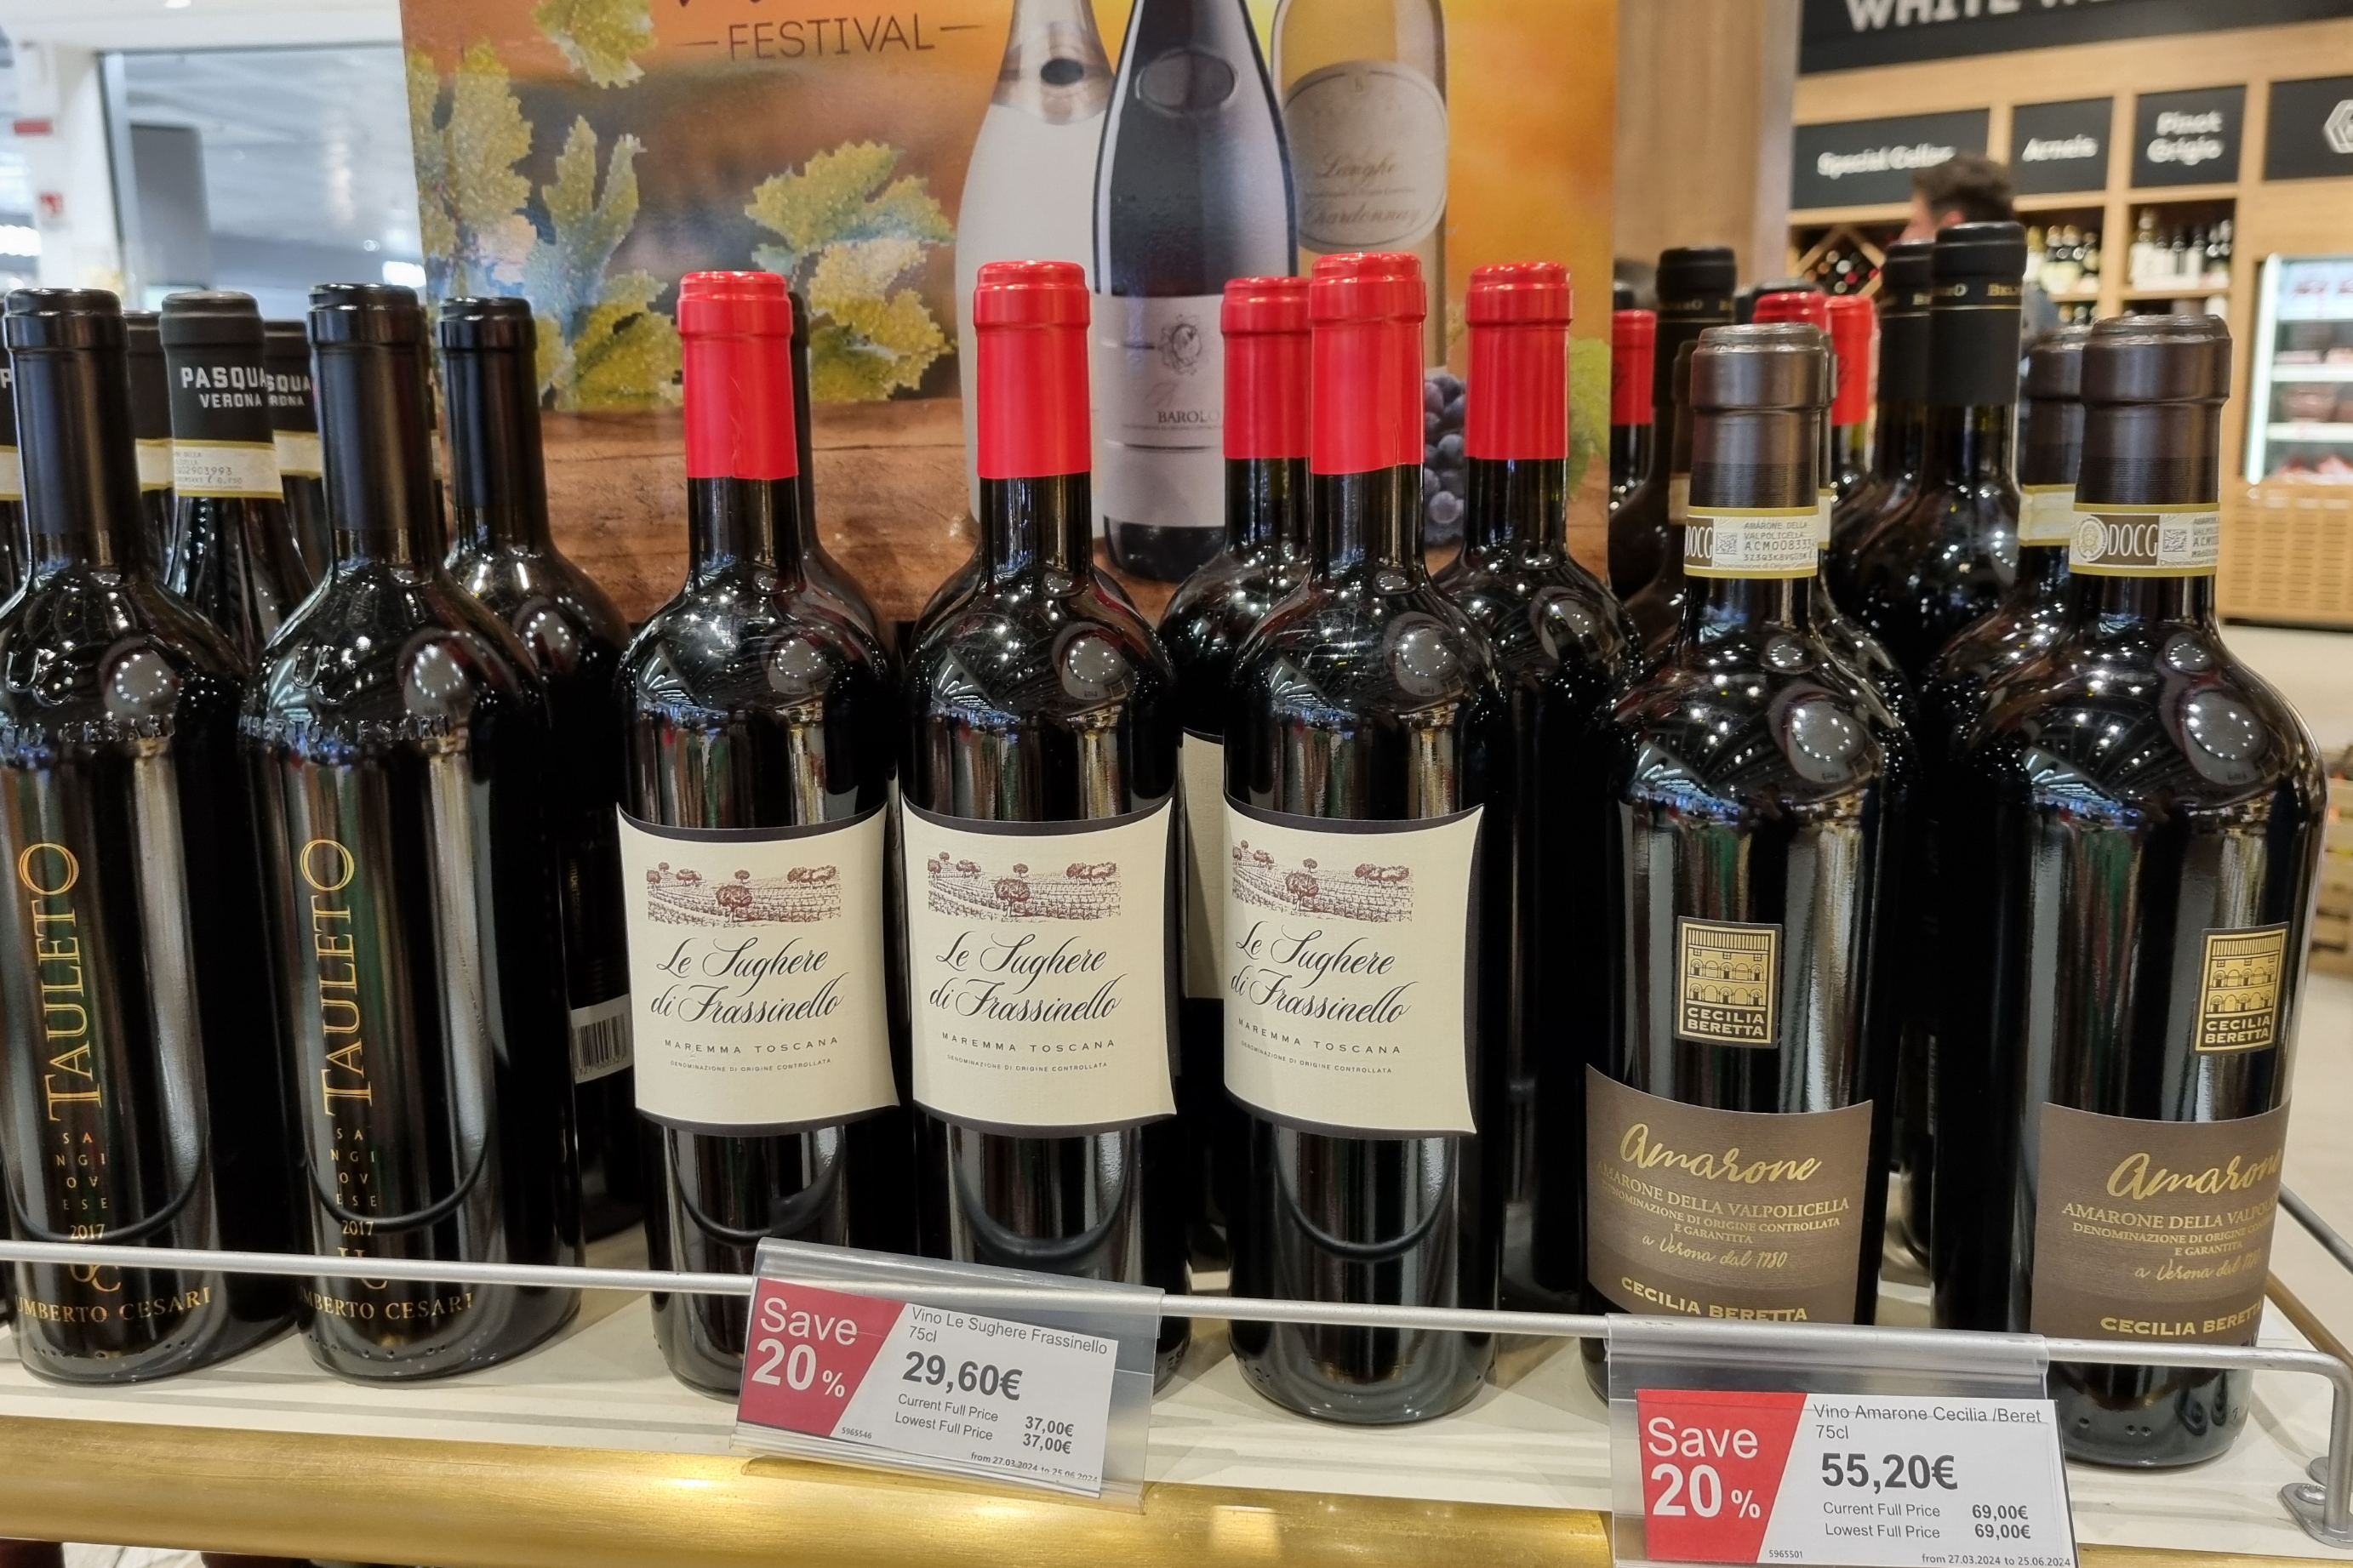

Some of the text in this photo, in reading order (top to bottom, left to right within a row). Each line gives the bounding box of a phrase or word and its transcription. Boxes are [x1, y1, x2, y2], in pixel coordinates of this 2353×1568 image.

[728, 13, 935, 61] FESTIVAL
[180, 367, 266, 390] PASQUA
[266, 373, 312, 393] SQUA
[198, 393, 263, 408] VERONA
[268, 395, 306, 407] RONA
[1157, 410, 1220, 424] BAROLO
[1745, 532, 1803, 540] VALPOLICELLA
[2108, 523, 2158, 557] DOCG
[935, 931, 1107, 995] Le Sughere
[1236, 921, 1396, 989] Le Sughere
[300, 839, 373, 1116] TAULETO
[656, 937, 829, 997] Le Sughere
[19, 842, 102, 1121] TAULETO
[650, 972, 850, 1023] di Frassinello
[929, 973, 1128, 1023] di Frassinello
[1231, 965, 1419, 1023] di Frassinello
[1687, 1007, 1765, 1023] CECILIA
[2206, 1015, 2270, 1031] CECILIA
[1238, 1018, 1401, 1054] MAREMMA TOSCANA
[1688, 1018, 1764, 1036] BERETTA
[2205, 1027, 2269, 1044] BERETTA
[665, 1036, 838, 1054] MAREMMA TOSCANA
[942, 1032, 1115, 1052] MAREMMA TOSCANA
[671, 1060, 726, 1072] DENOMINAZIONE
[777, 1058, 831, 1070] CONTROLLATA
[947, 1054, 1002, 1069] DENOMINAZIONE
[1052, 1062, 1108, 1072] CONTROLLATA
[1241, 1041, 1287, 1062] DENOMINAZIONE
[1299, 1060, 1332, 1070] ORIGINE
[1334, 1065, 1392, 1074] CONTROLLATA
[1619, 1123, 1822, 1183] Amarone
[1596, 1161, 1849, 1218] AMARONE DELLA VALPOLICELLA
[1602, 1180, 1841, 1233] DENOMINAZIONE DI ORIGINE CONTROLLATA
[2062, 1202, 2164, 1229] AMARONE
[2168, 1215, 2223, 1229] DELLA
[70, 1223, 106, 1240] 2017
[342, 1220, 374, 1236] 2017
[1673, 1223, 1753, 1244] E GARANTITA
[2072, 1222, 2247, 1244] DENOMINAZIONE DI ORIGINE
[1642, 1234, 1656, 1246] a
[1659, 1234, 1717, 1263] Verona
[1719, 1250, 1753, 1267] dal
[2174, 1240, 2243, 1256] E GARANTITA
[2134, 1267, 2151, 1278] a
[2156, 1258, 2213, 1280] Verona
[15, 1286, 211, 1323] UMBERTO CESARI
[386, 1292, 472, 1320] CESARI
[1621, 1276, 1808, 1321] CECILIA BERETTA
[760, 1297, 857, 1346] Save
[2100, 1299, 2262, 1336] CECILIA BERETTA
[909, 1326, 937, 1343] 75cl
[912, 1307, 1108, 1354] Vino Le Sughere Frassinello
[903, 1351, 1023, 1400] 29,60€
[899, 1394, 1074, 1437] Current Full Price 37,00€
[1813, 1404, 2042, 1423] Vino Amarone Cecilia /Beret
[842, 1427, 872, 1440] 5965546
[894, 1411, 1071, 1454] Lowest Full Price 37,00€
[1648, 1417, 1759, 1459] Save
[1815, 1424, 1849, 1440] 75cl
[971, 1451, 991, 1463] from
[992, 1457, 1038, 1473] 27.03.2024
[1041, 1466, 1050, 1474] to
[1821, 1452, 1958, 1495] 55,20€
[1823, 1502, 2029, 1522] Current Full Price 69,00€
[1825, 1523, 2031, 1541] Lowest Full Price 69,00€
[1768, 1549, 1803, 1559] 5965501
[1922, 1554, 2070, 1567] from 27.03.2024 to 25.06.2024
